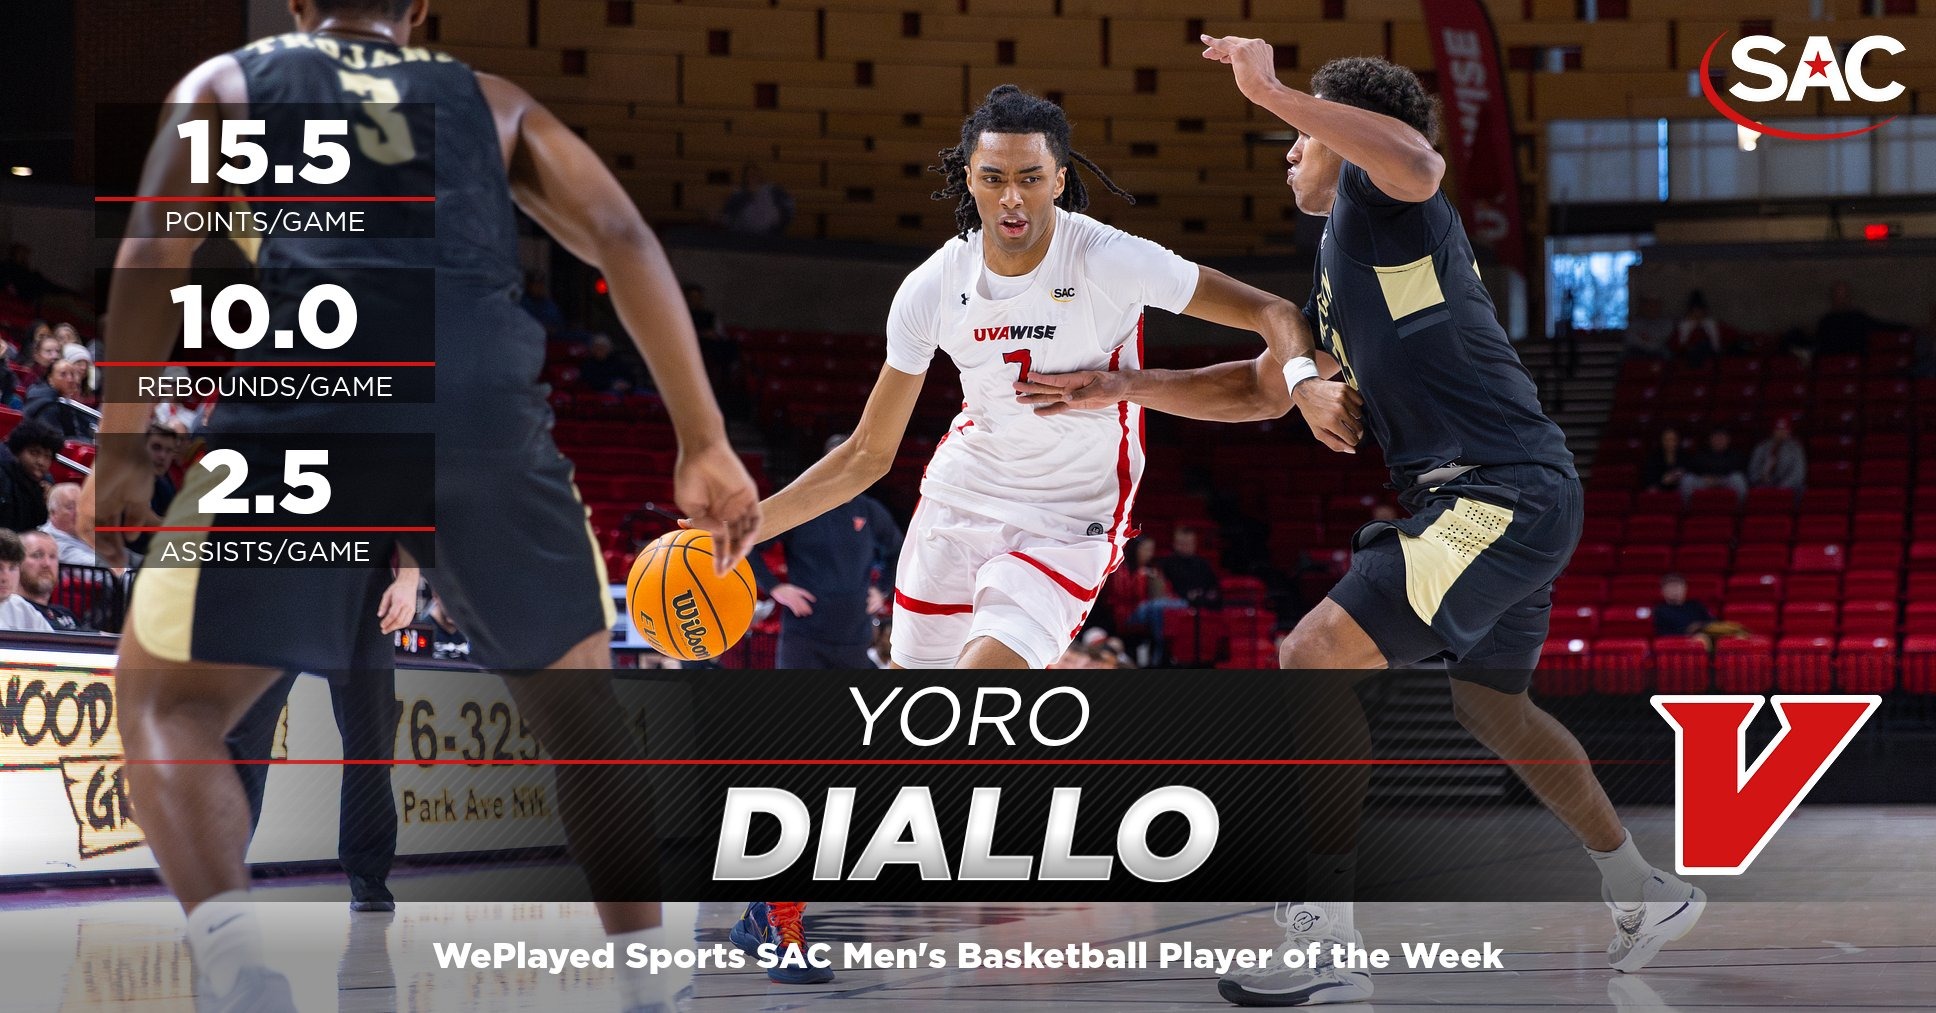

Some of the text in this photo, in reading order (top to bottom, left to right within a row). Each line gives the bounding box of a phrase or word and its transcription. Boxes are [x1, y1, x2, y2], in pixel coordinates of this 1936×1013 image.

[337, 69, 416, 165] 3
[1053, 287, 1076, 299] SAC
[973, 325, 1057, 342] UVAWISE
[1002, 348, 1032, 396] 7
[671, 588, 711, 659] Wilson
[403, 788, 457, 824] Park
[464, 788, 505, 821] Ave
